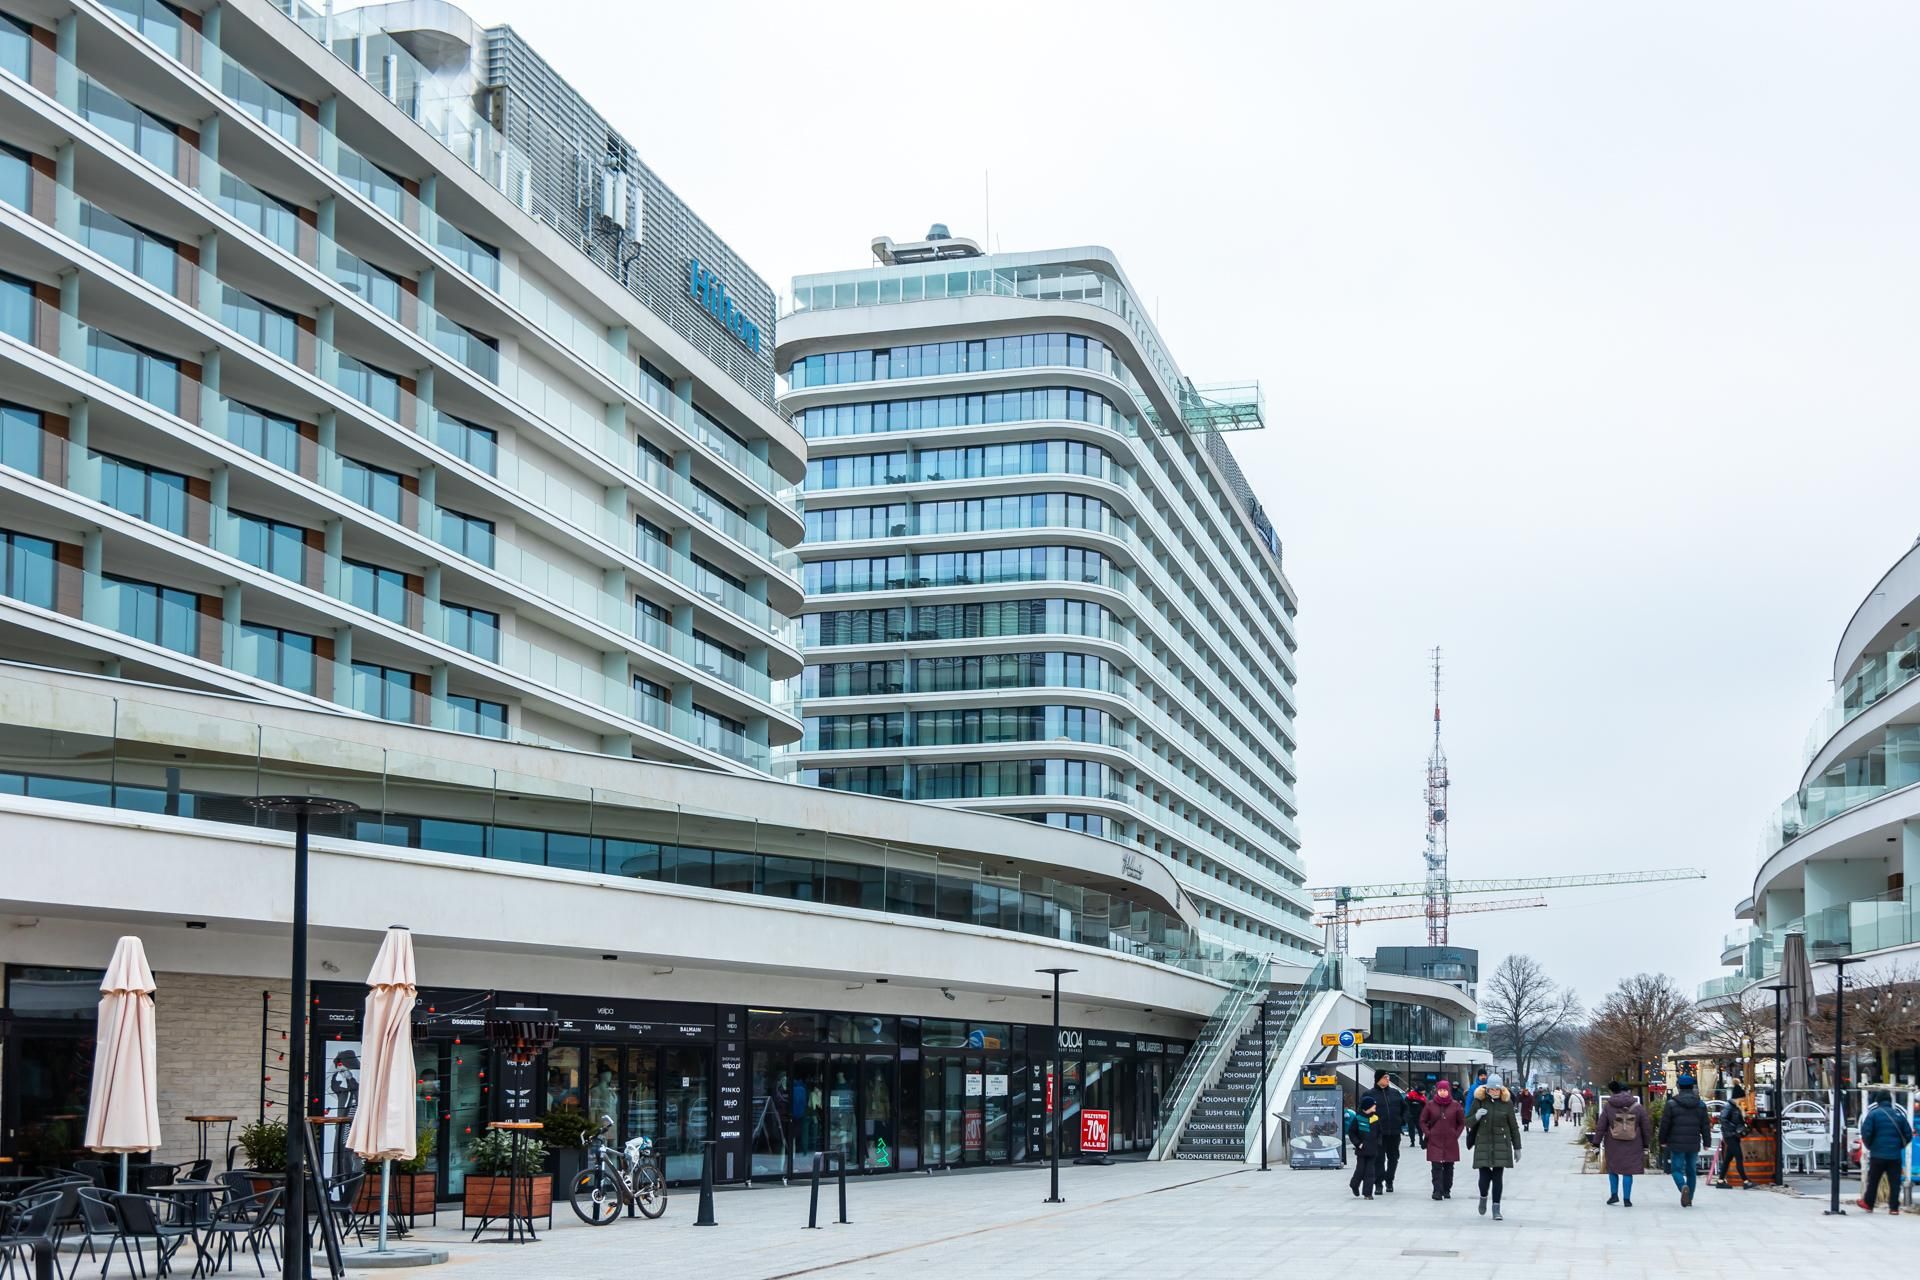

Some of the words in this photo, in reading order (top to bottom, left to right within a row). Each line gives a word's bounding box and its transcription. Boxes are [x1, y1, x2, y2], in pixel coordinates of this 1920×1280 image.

[690, 257, 760, 354] Hilton
[594, 1023, 616, 1031] MaxMara
[1360, 1048, 1393, 1061] OYSTER
[1084, 1120, 1106, 1141] -70%
